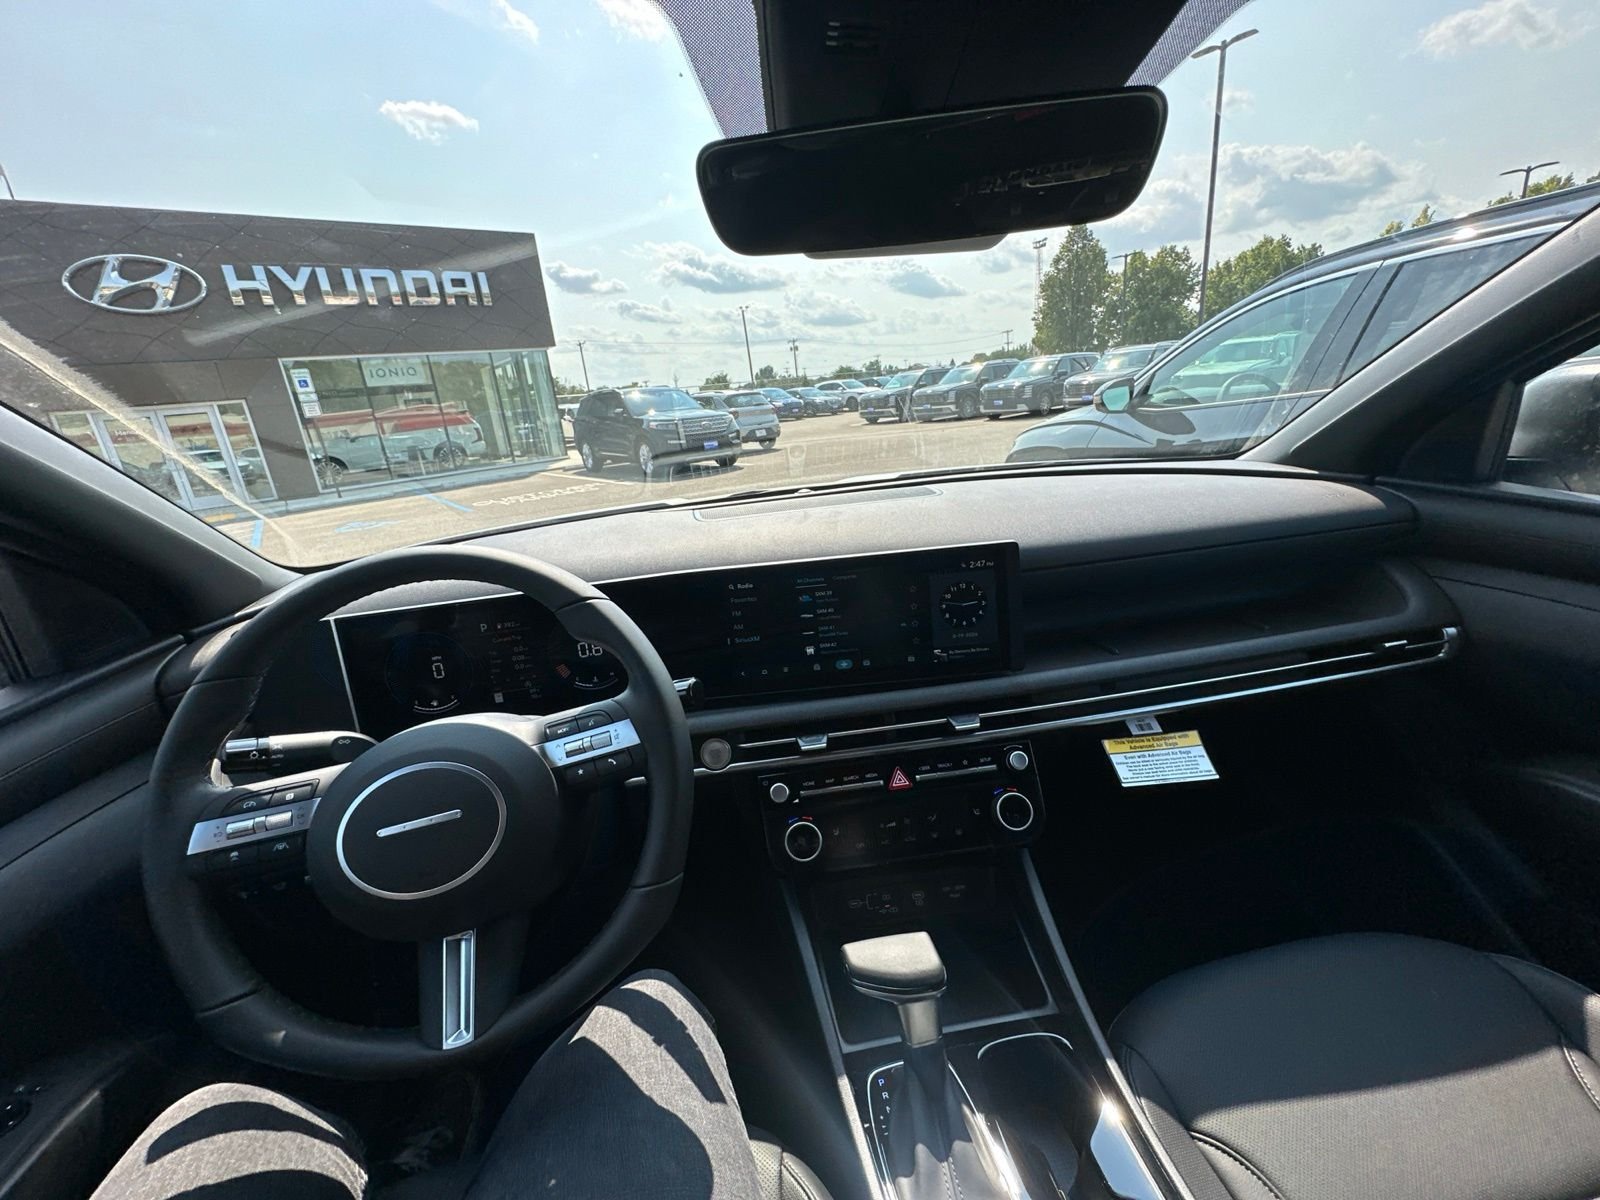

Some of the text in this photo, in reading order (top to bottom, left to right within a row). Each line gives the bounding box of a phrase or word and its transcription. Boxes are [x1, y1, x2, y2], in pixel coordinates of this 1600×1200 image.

[221, 264, 493, 307] HYUNDAI
[969, 560, 985, 569] 2:47
[480, 623, 487, 632] P
[432, 662, 445, 679] 0
[878, 1078, 885, 1087] P
[882, 1091, 889, 1100] R
